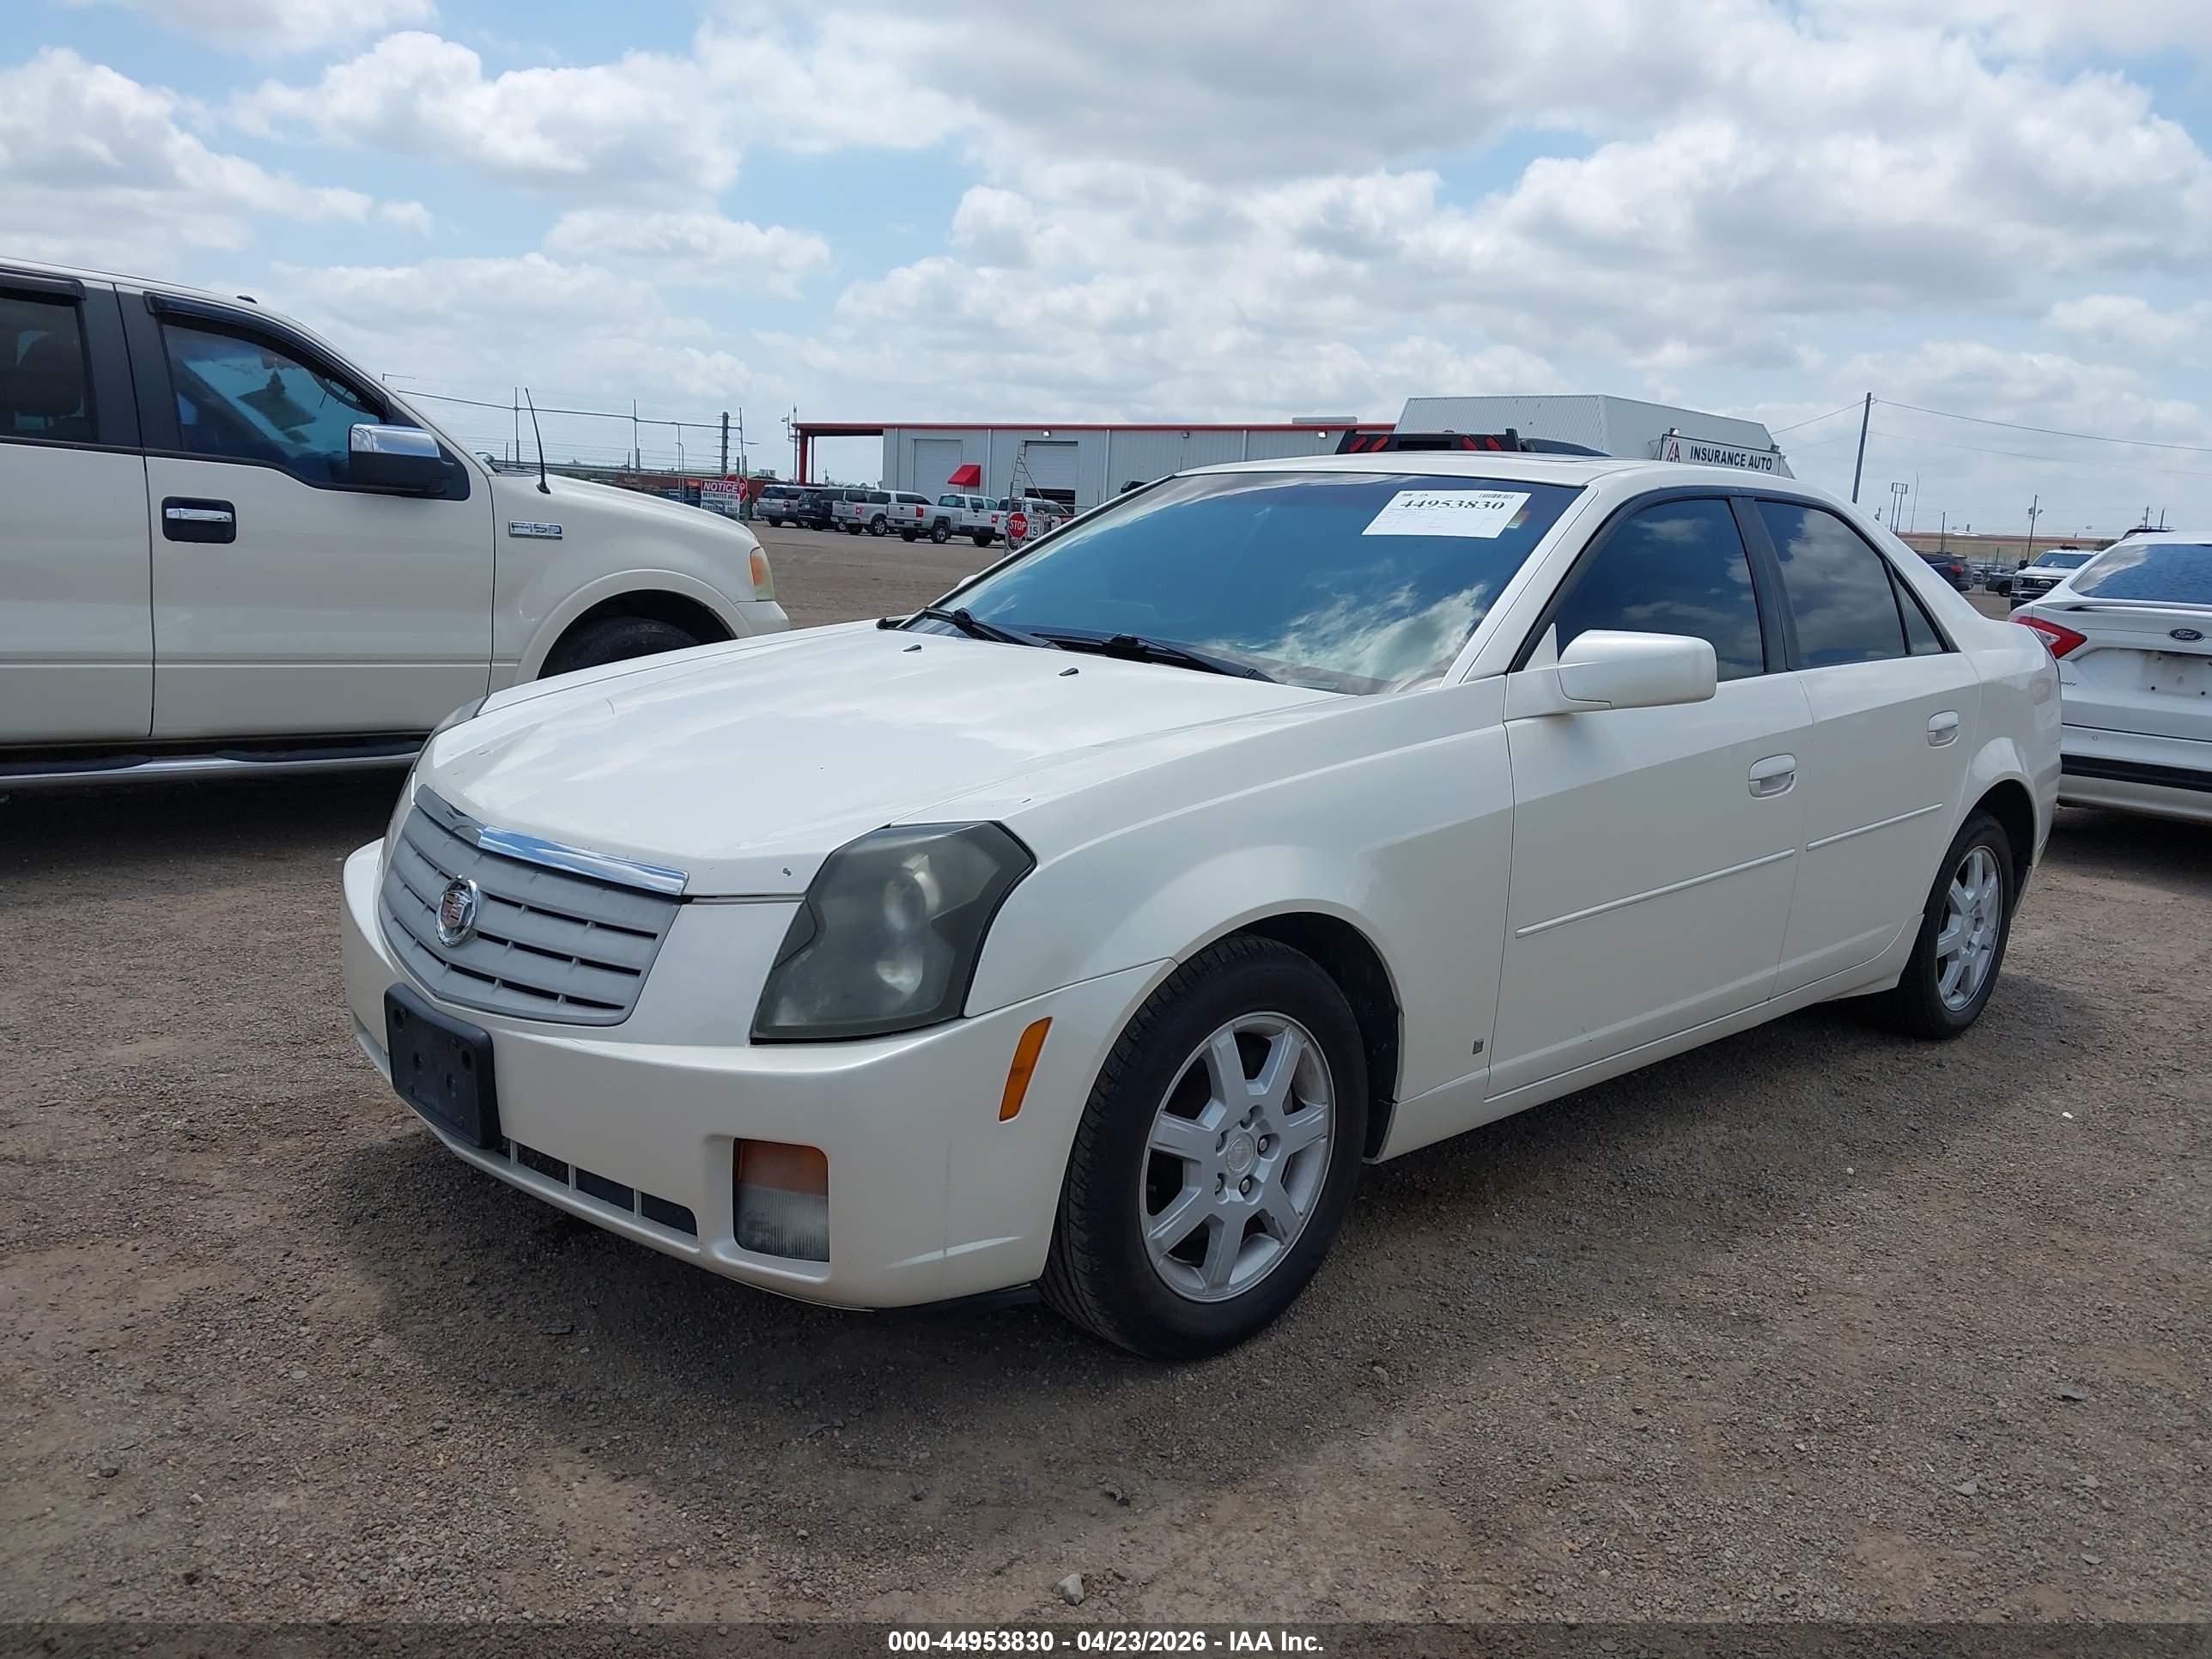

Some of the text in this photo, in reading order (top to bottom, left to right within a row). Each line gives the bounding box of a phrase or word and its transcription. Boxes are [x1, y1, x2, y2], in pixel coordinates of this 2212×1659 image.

[1690, 445, 1772, 471] INSURANCE AUTO
[703, 482, 738, 493] NOTICE
[1401, 499, 1505, 510] 44953830
[1009, 520, 1026, 531] STOP
[1030, 526, 1038, 537] 15
[2175, 629, 2197, 640] Ford
